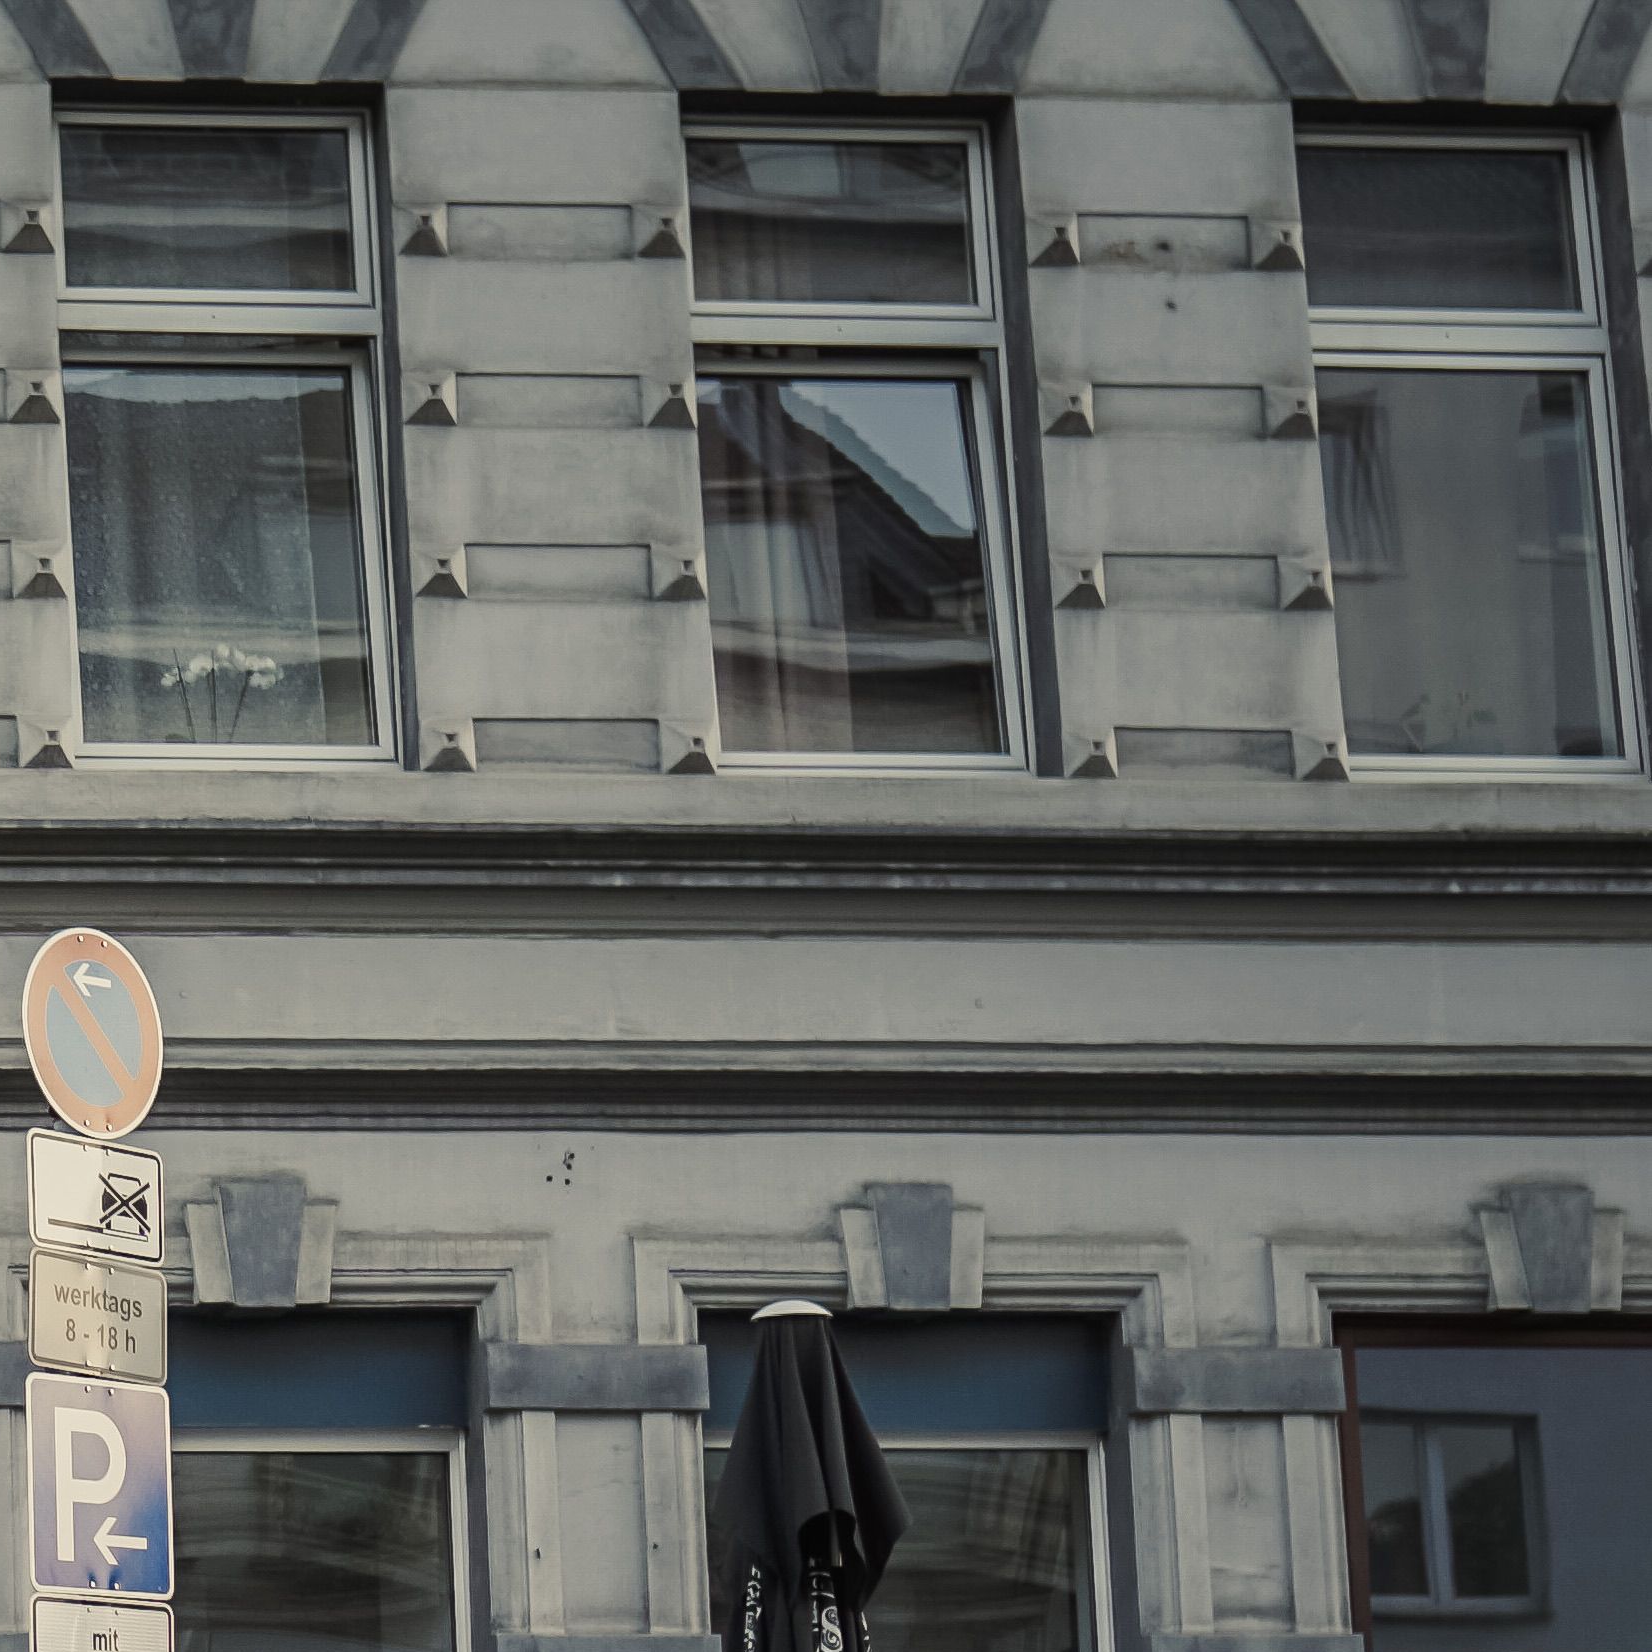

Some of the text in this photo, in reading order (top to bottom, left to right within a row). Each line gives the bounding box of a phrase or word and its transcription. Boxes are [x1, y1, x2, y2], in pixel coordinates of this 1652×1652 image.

[54, 1284, 142, 1321] werktags
[66, 1318, 76, 1342] 8
[97, 1323, 118, 1350] 18
[125, 1329, 136, 1354] h
[54, 1406, 127, 1562] P
[92, 1627, 120, 1652] mit
